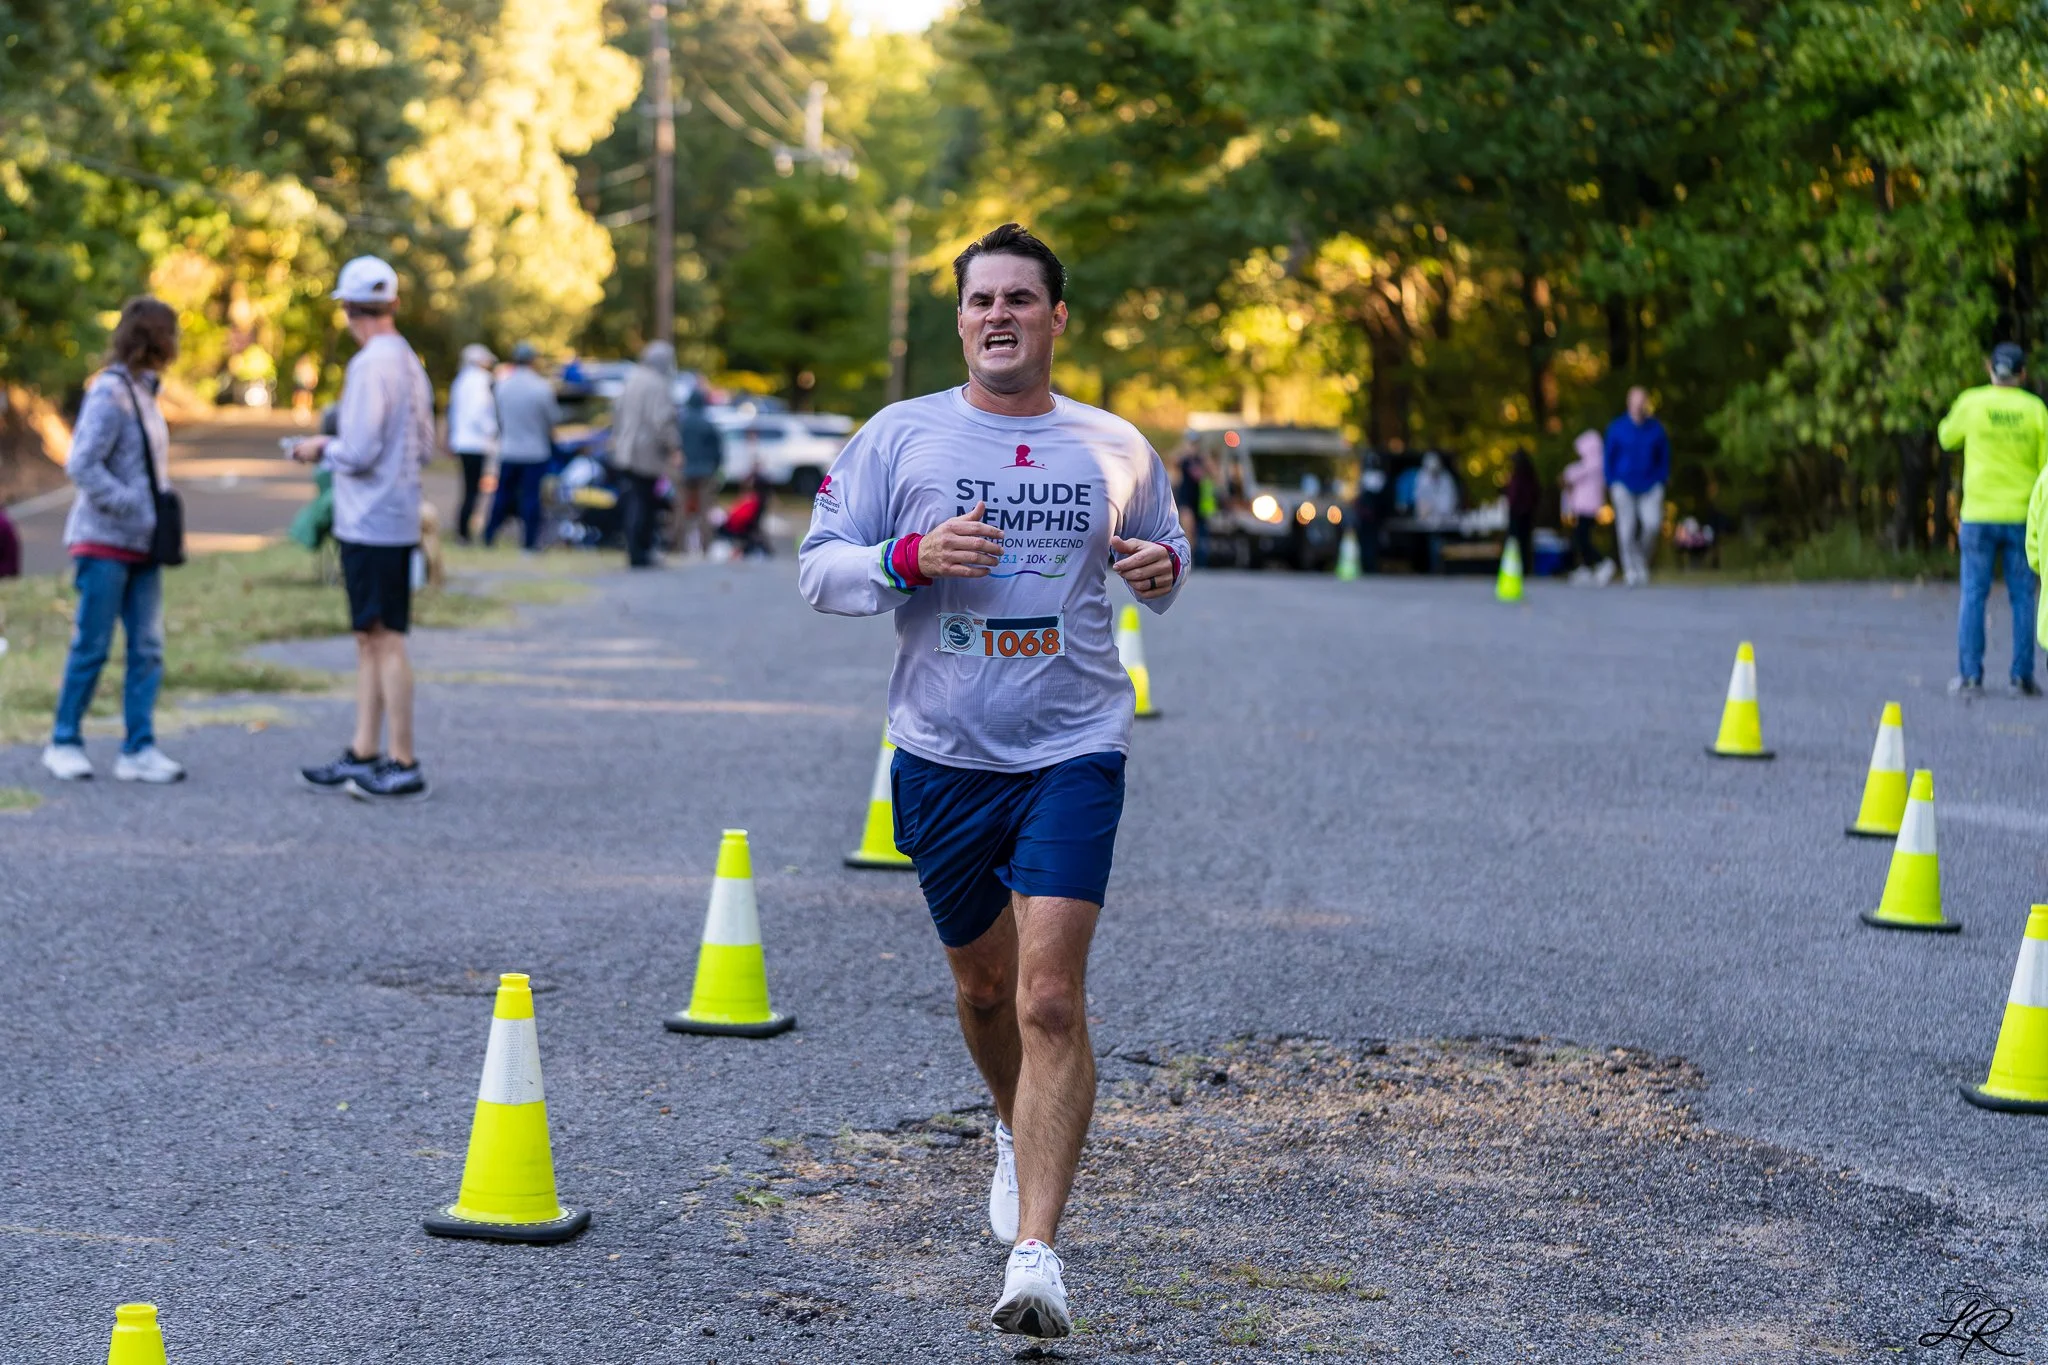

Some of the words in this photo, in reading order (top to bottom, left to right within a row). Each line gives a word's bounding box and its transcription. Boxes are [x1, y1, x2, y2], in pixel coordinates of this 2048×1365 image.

[956, 479, 998, 503] ST.
[1007, 483, 1091, 506] JUDE
[1026, 538, 1084, 549] WEEKEND
[1026, 554, 1047, 564] 10K
[1054, 554, 1068, 564] 5K
[982, 628, 1060, 657] 1068
